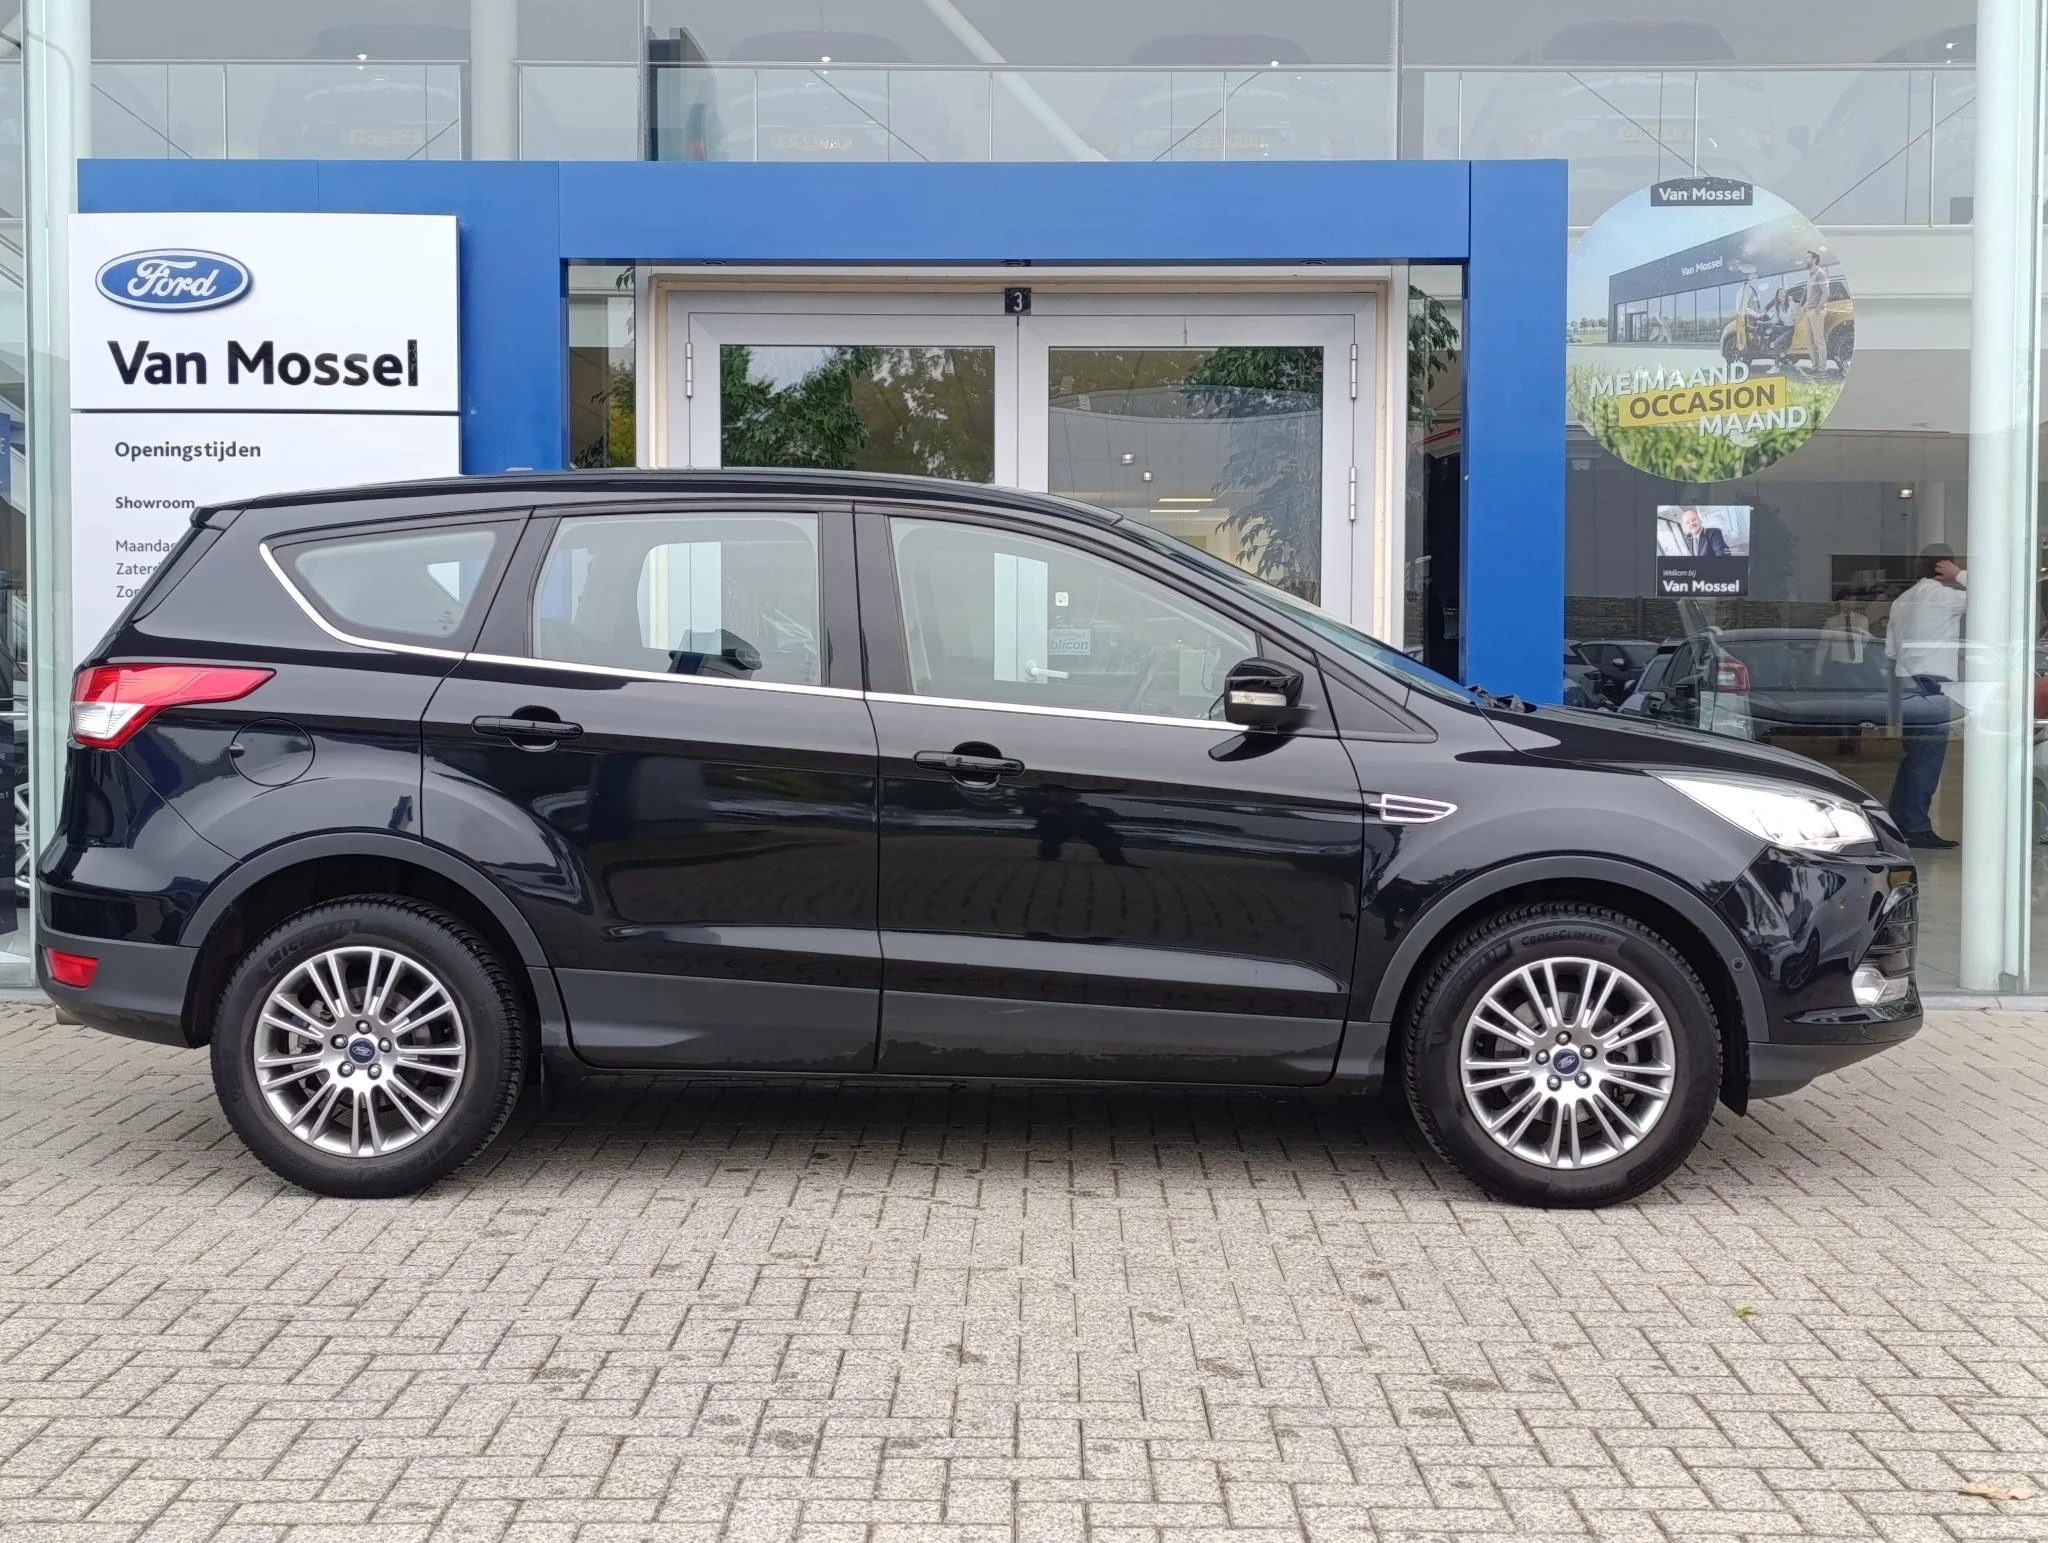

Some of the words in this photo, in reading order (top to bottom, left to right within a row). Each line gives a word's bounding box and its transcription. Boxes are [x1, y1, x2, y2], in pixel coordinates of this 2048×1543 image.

[1659, 187, 1688, 201] Van
[1692, 186, 1745, 201] Mossel
[1681, 266, 1695, 277] Van
[1695, 256, 1723, 273] Mossel
[127, 258, 220, 297] Ford
[1013, 291, 1023, 311] 3
[107, 340, 207, 385] Van
[227, 339, 418, 387] Mossel
[1590, 361, 1750, 398] MEIMAAND
[1629, 384, 1776, 420] OCCASION
[1699, 405, 1808, 438] MAAND
[114, 441, 261, 462] Openingstijden
[114, 496, 196, 509] Showroom
[1663, 569, 1687, 577] Welkom
[1688, 569, 1696, 577] bij
[1662, 580, 1689, 592] Van
[1692, 579, 1740, 593] Mossel
